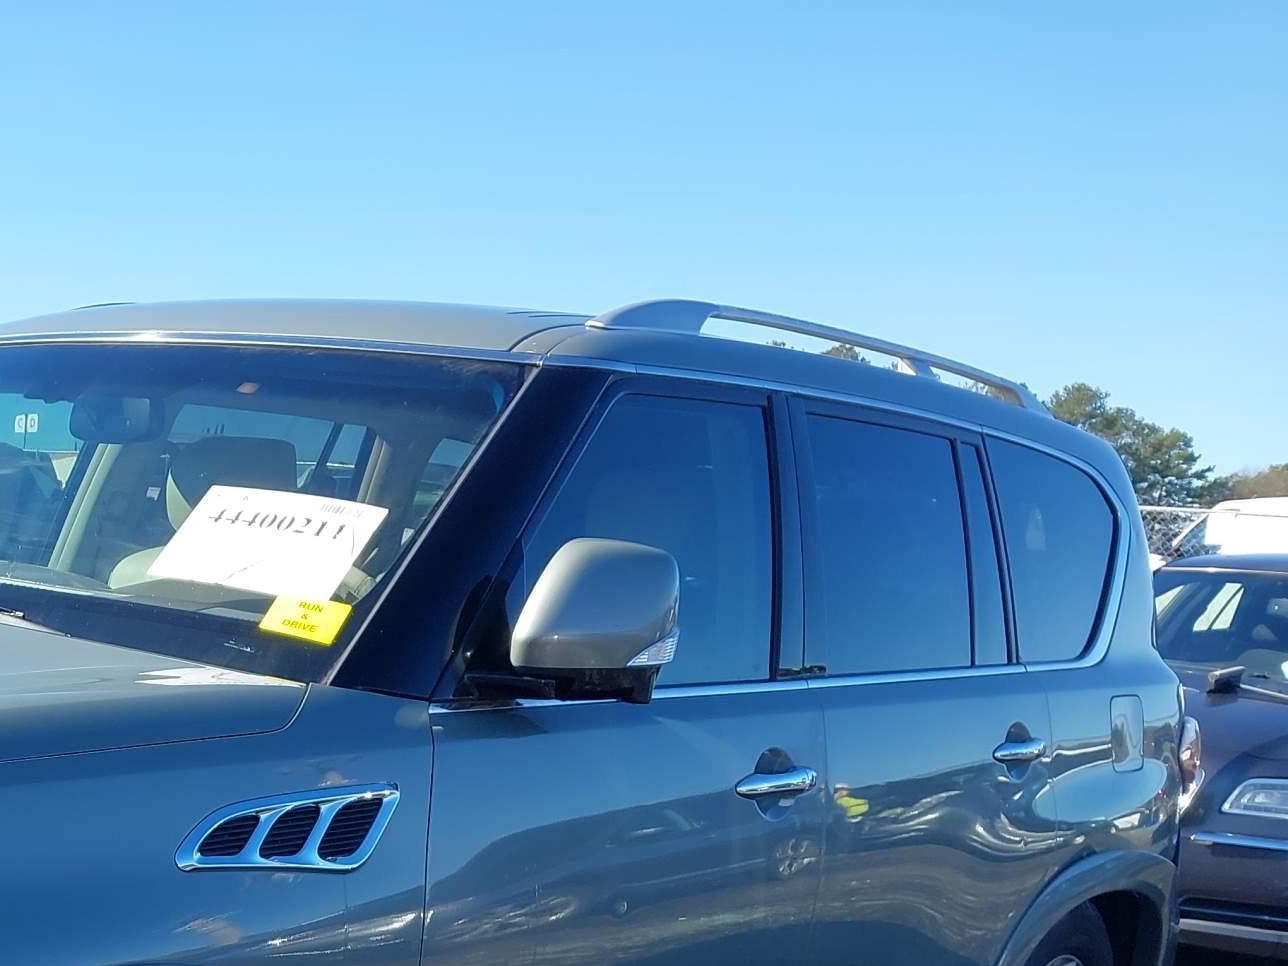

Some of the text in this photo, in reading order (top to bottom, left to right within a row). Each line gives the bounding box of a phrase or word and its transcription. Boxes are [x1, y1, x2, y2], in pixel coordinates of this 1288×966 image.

[208, 508, 347, 540] 44400211
[298, 601, 324, 613] RUN
[281, 619, 320, 633] DRIVE
